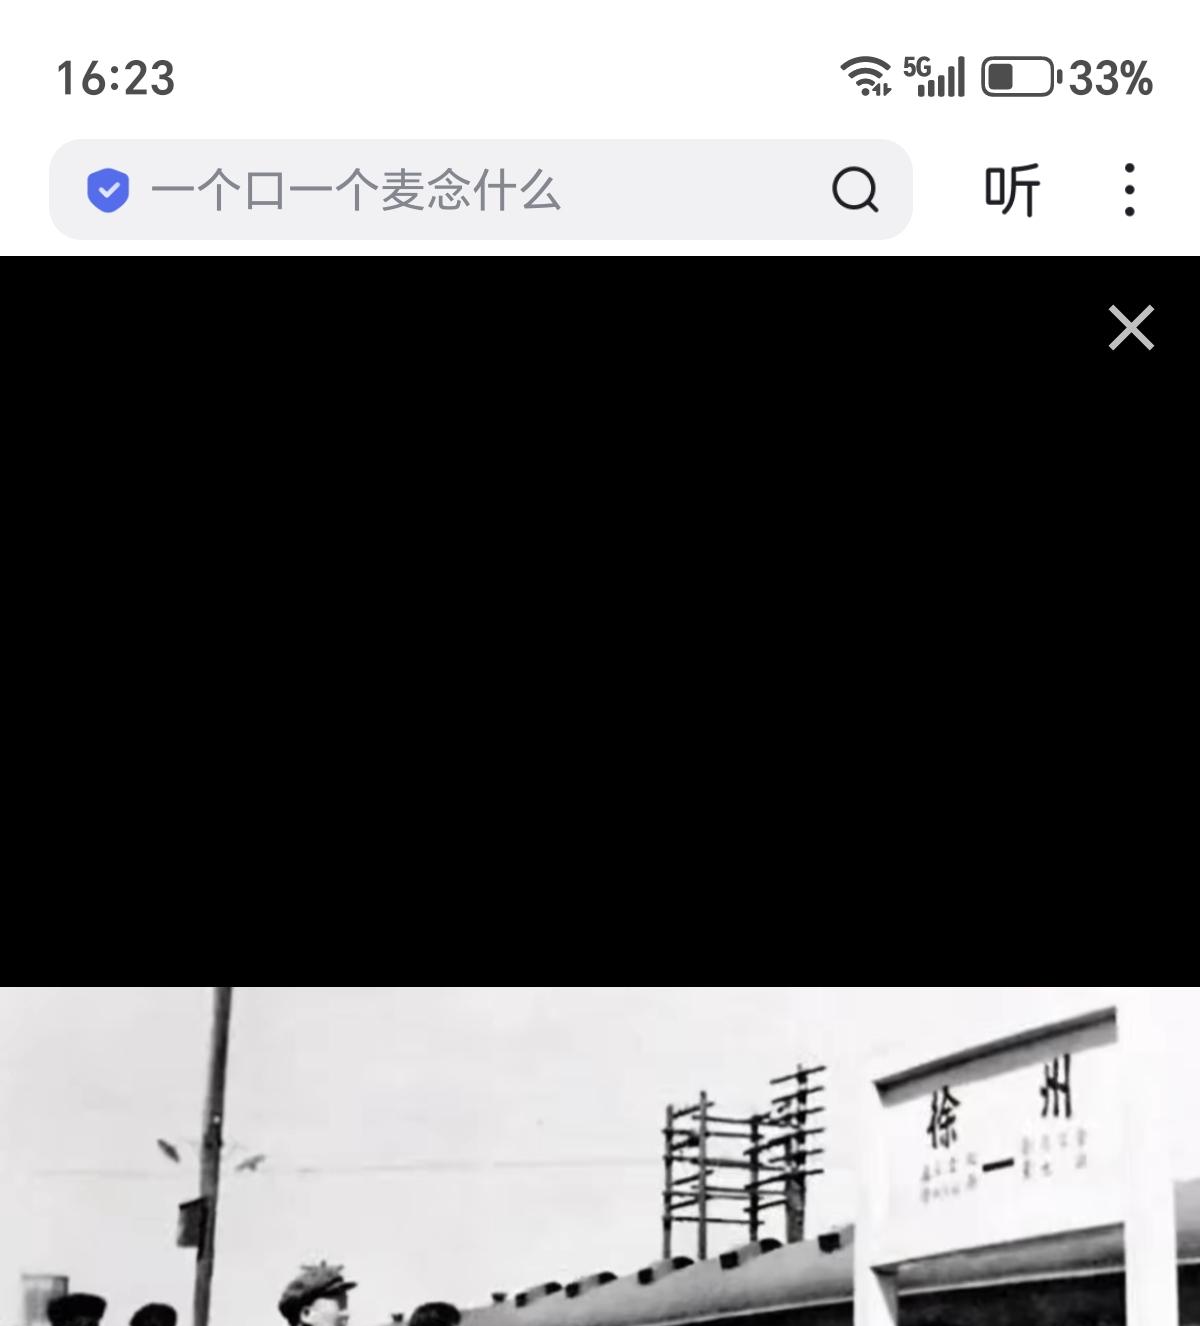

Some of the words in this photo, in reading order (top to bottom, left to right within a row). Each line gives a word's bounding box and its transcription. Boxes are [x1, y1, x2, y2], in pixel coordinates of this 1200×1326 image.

[57, 59, 174, 96] 16:23
[903, 55, 932, 78] 5G
[1069, 59, 1154, 96] 33%
[151, 167, 562, 212] 一个口一个麦念什么
[984, 162, 1042, 219] 听
